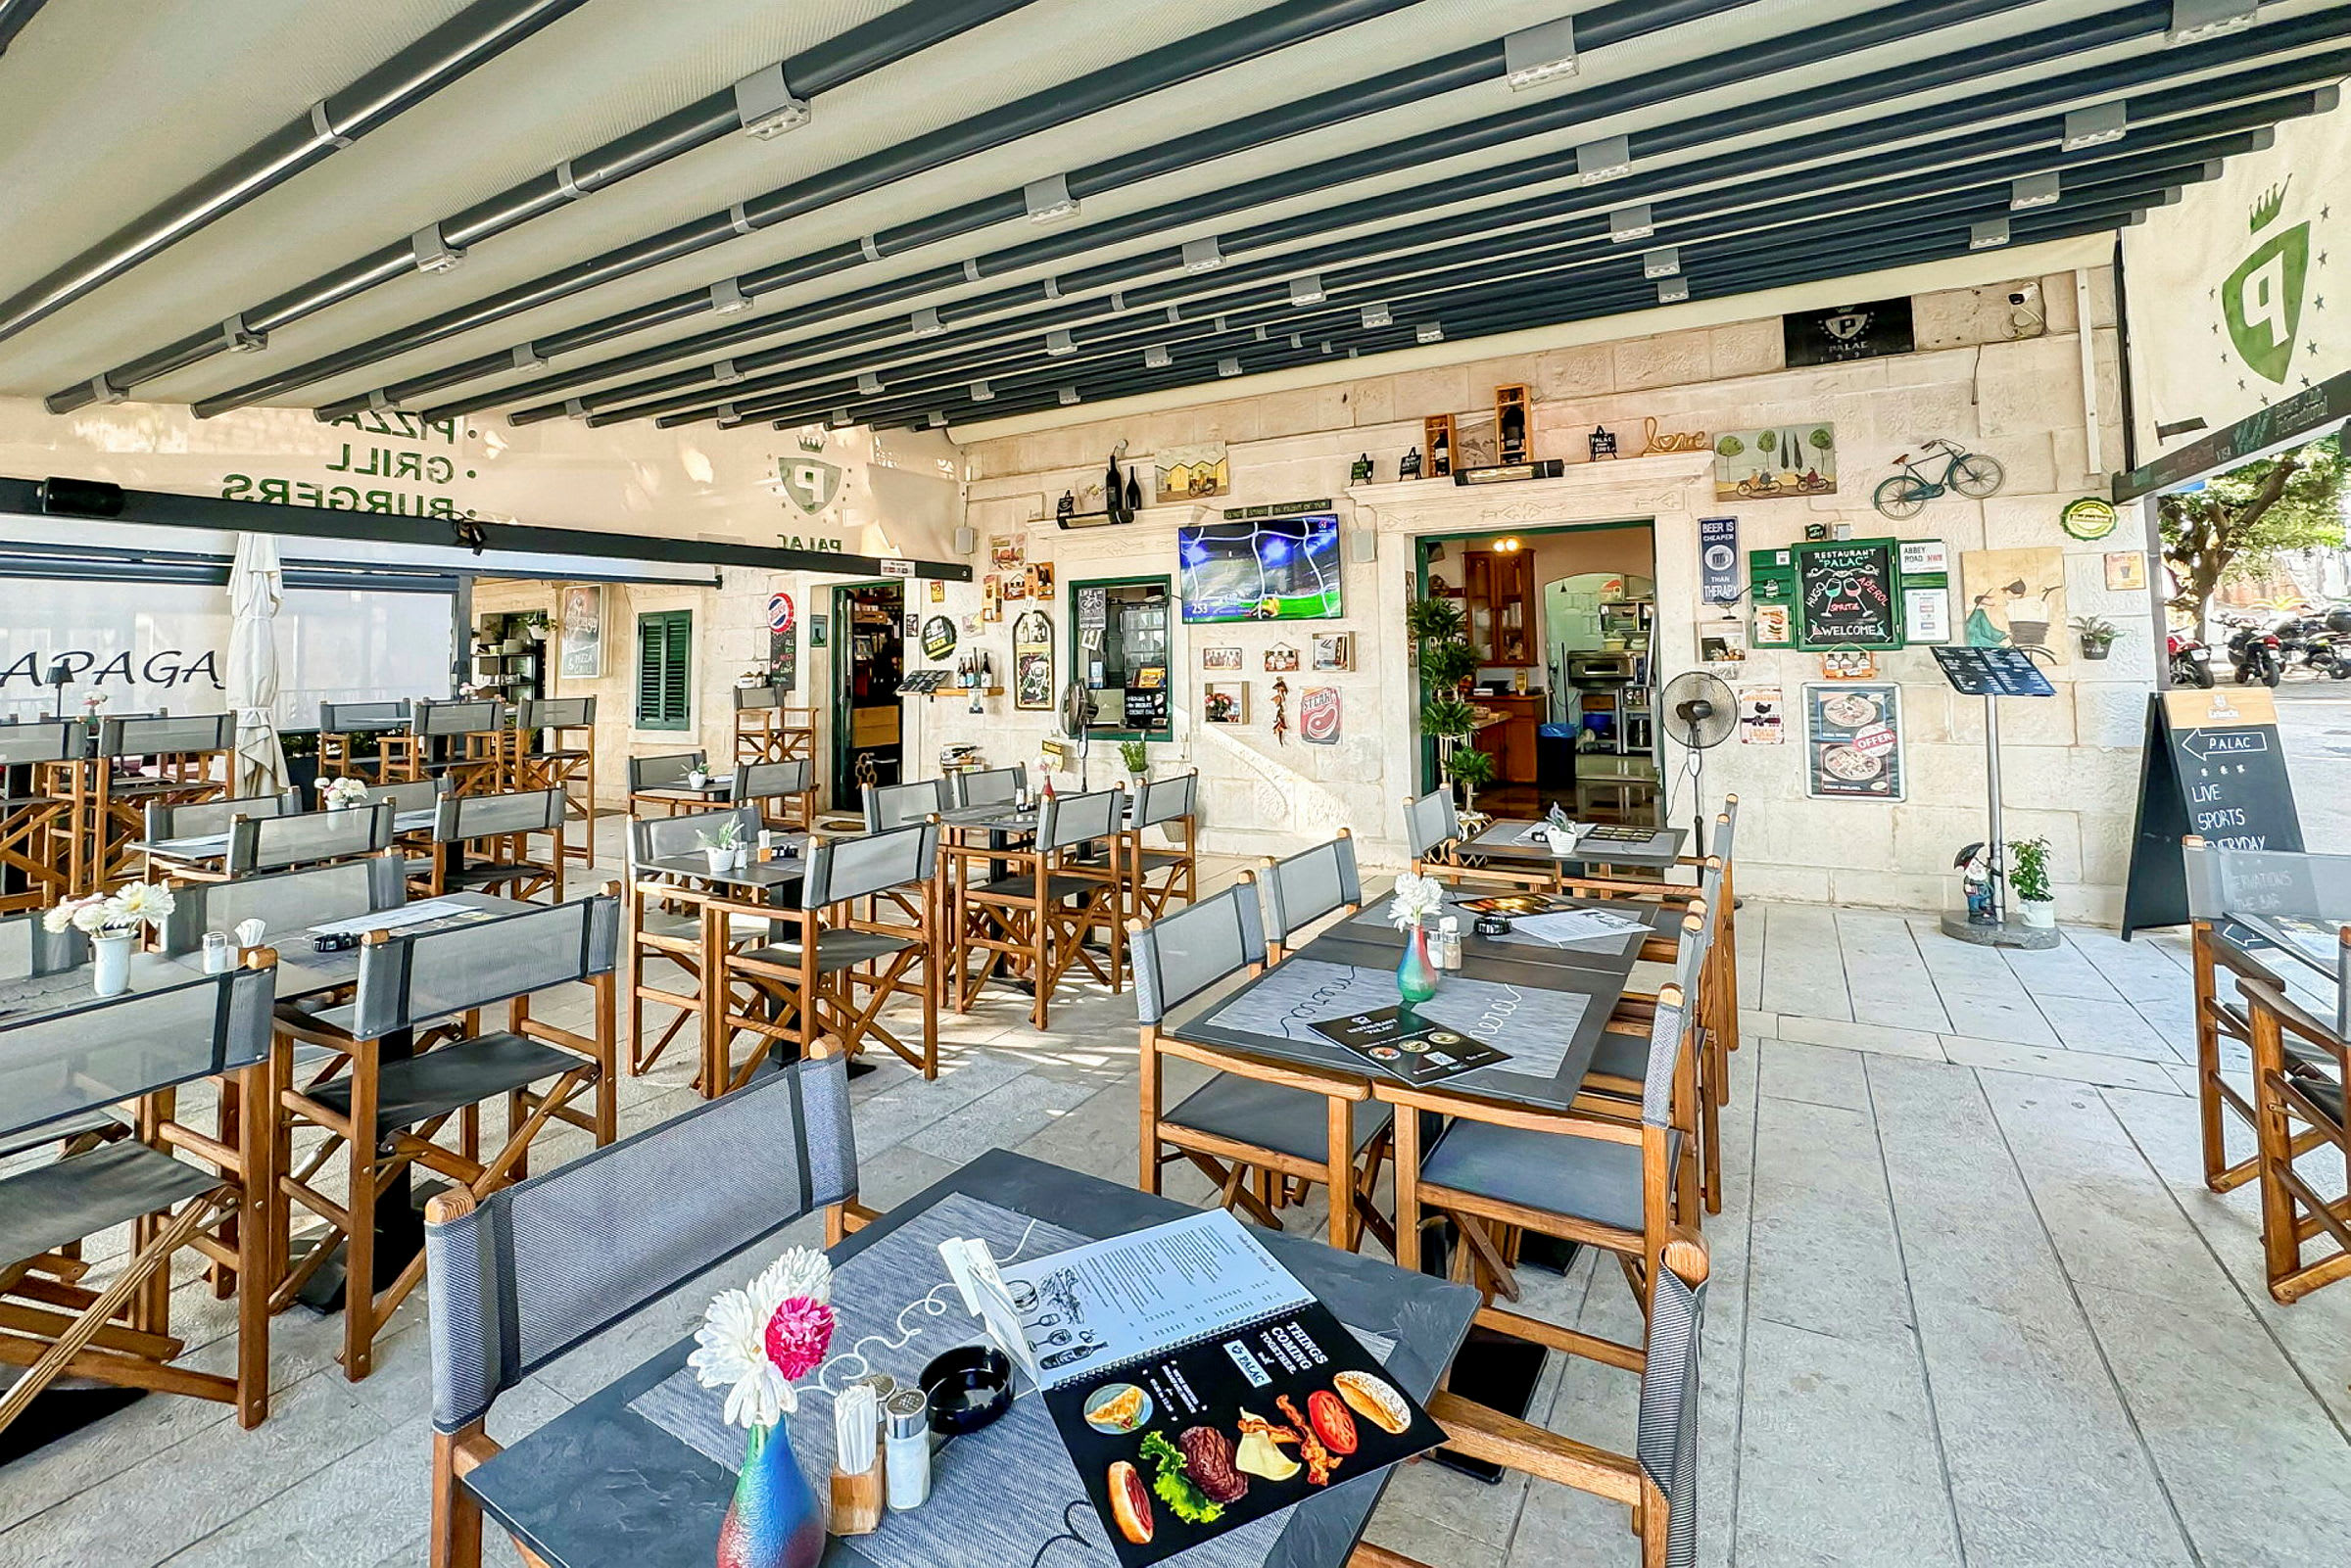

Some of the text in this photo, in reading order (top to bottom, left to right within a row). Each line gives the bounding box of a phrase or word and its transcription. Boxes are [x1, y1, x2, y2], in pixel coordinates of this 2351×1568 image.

[1702, 521, 1735, 534] BEER IS
[1813, 547, 1877, 560] RESTAURANT
[1703, 584, 1739, 598] THERAPY
[1804, 581, 1828, 608] HUGO
[1856, 576, 1890, 607] APEROL
[1192, 603, 1208, 614] 253
[1821, 624, 1878, 637] WELCOME
[0, 650, 226, 690] APAGA
[1303, 691, 1333, 711] STEAK
[2209, 736, 2251, 750] PALAC
[2197, 807, 2246, 831] SPORTS
[1271, 1326, 1314, 1371] COMING
[1286, 1320, 1329, 1365] THINGS
[1239, 1354, 1267, 1384] PALAC
